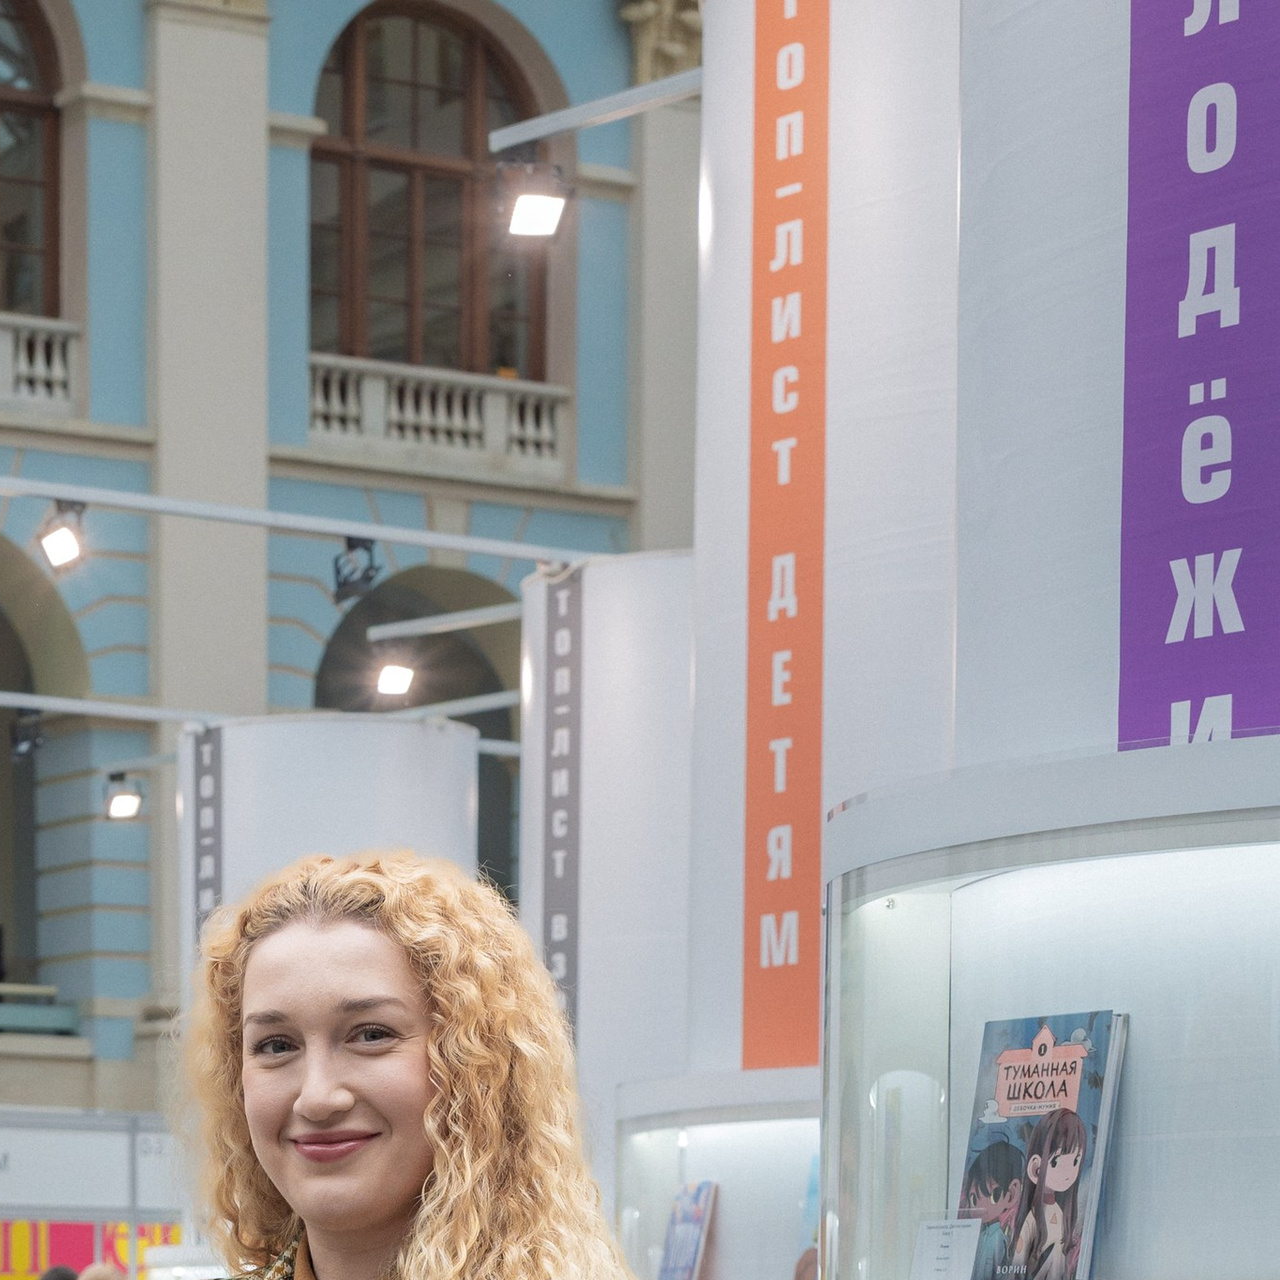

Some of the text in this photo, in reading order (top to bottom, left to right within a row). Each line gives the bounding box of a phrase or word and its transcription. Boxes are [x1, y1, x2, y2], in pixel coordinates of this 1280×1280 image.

[760, 552, 799, 970] ДЕТЯМ
[1004, 1060, 1078, 1081] ТУМАННАЯ
[1007, 1080, 1068, 1100] ШКОЛА
